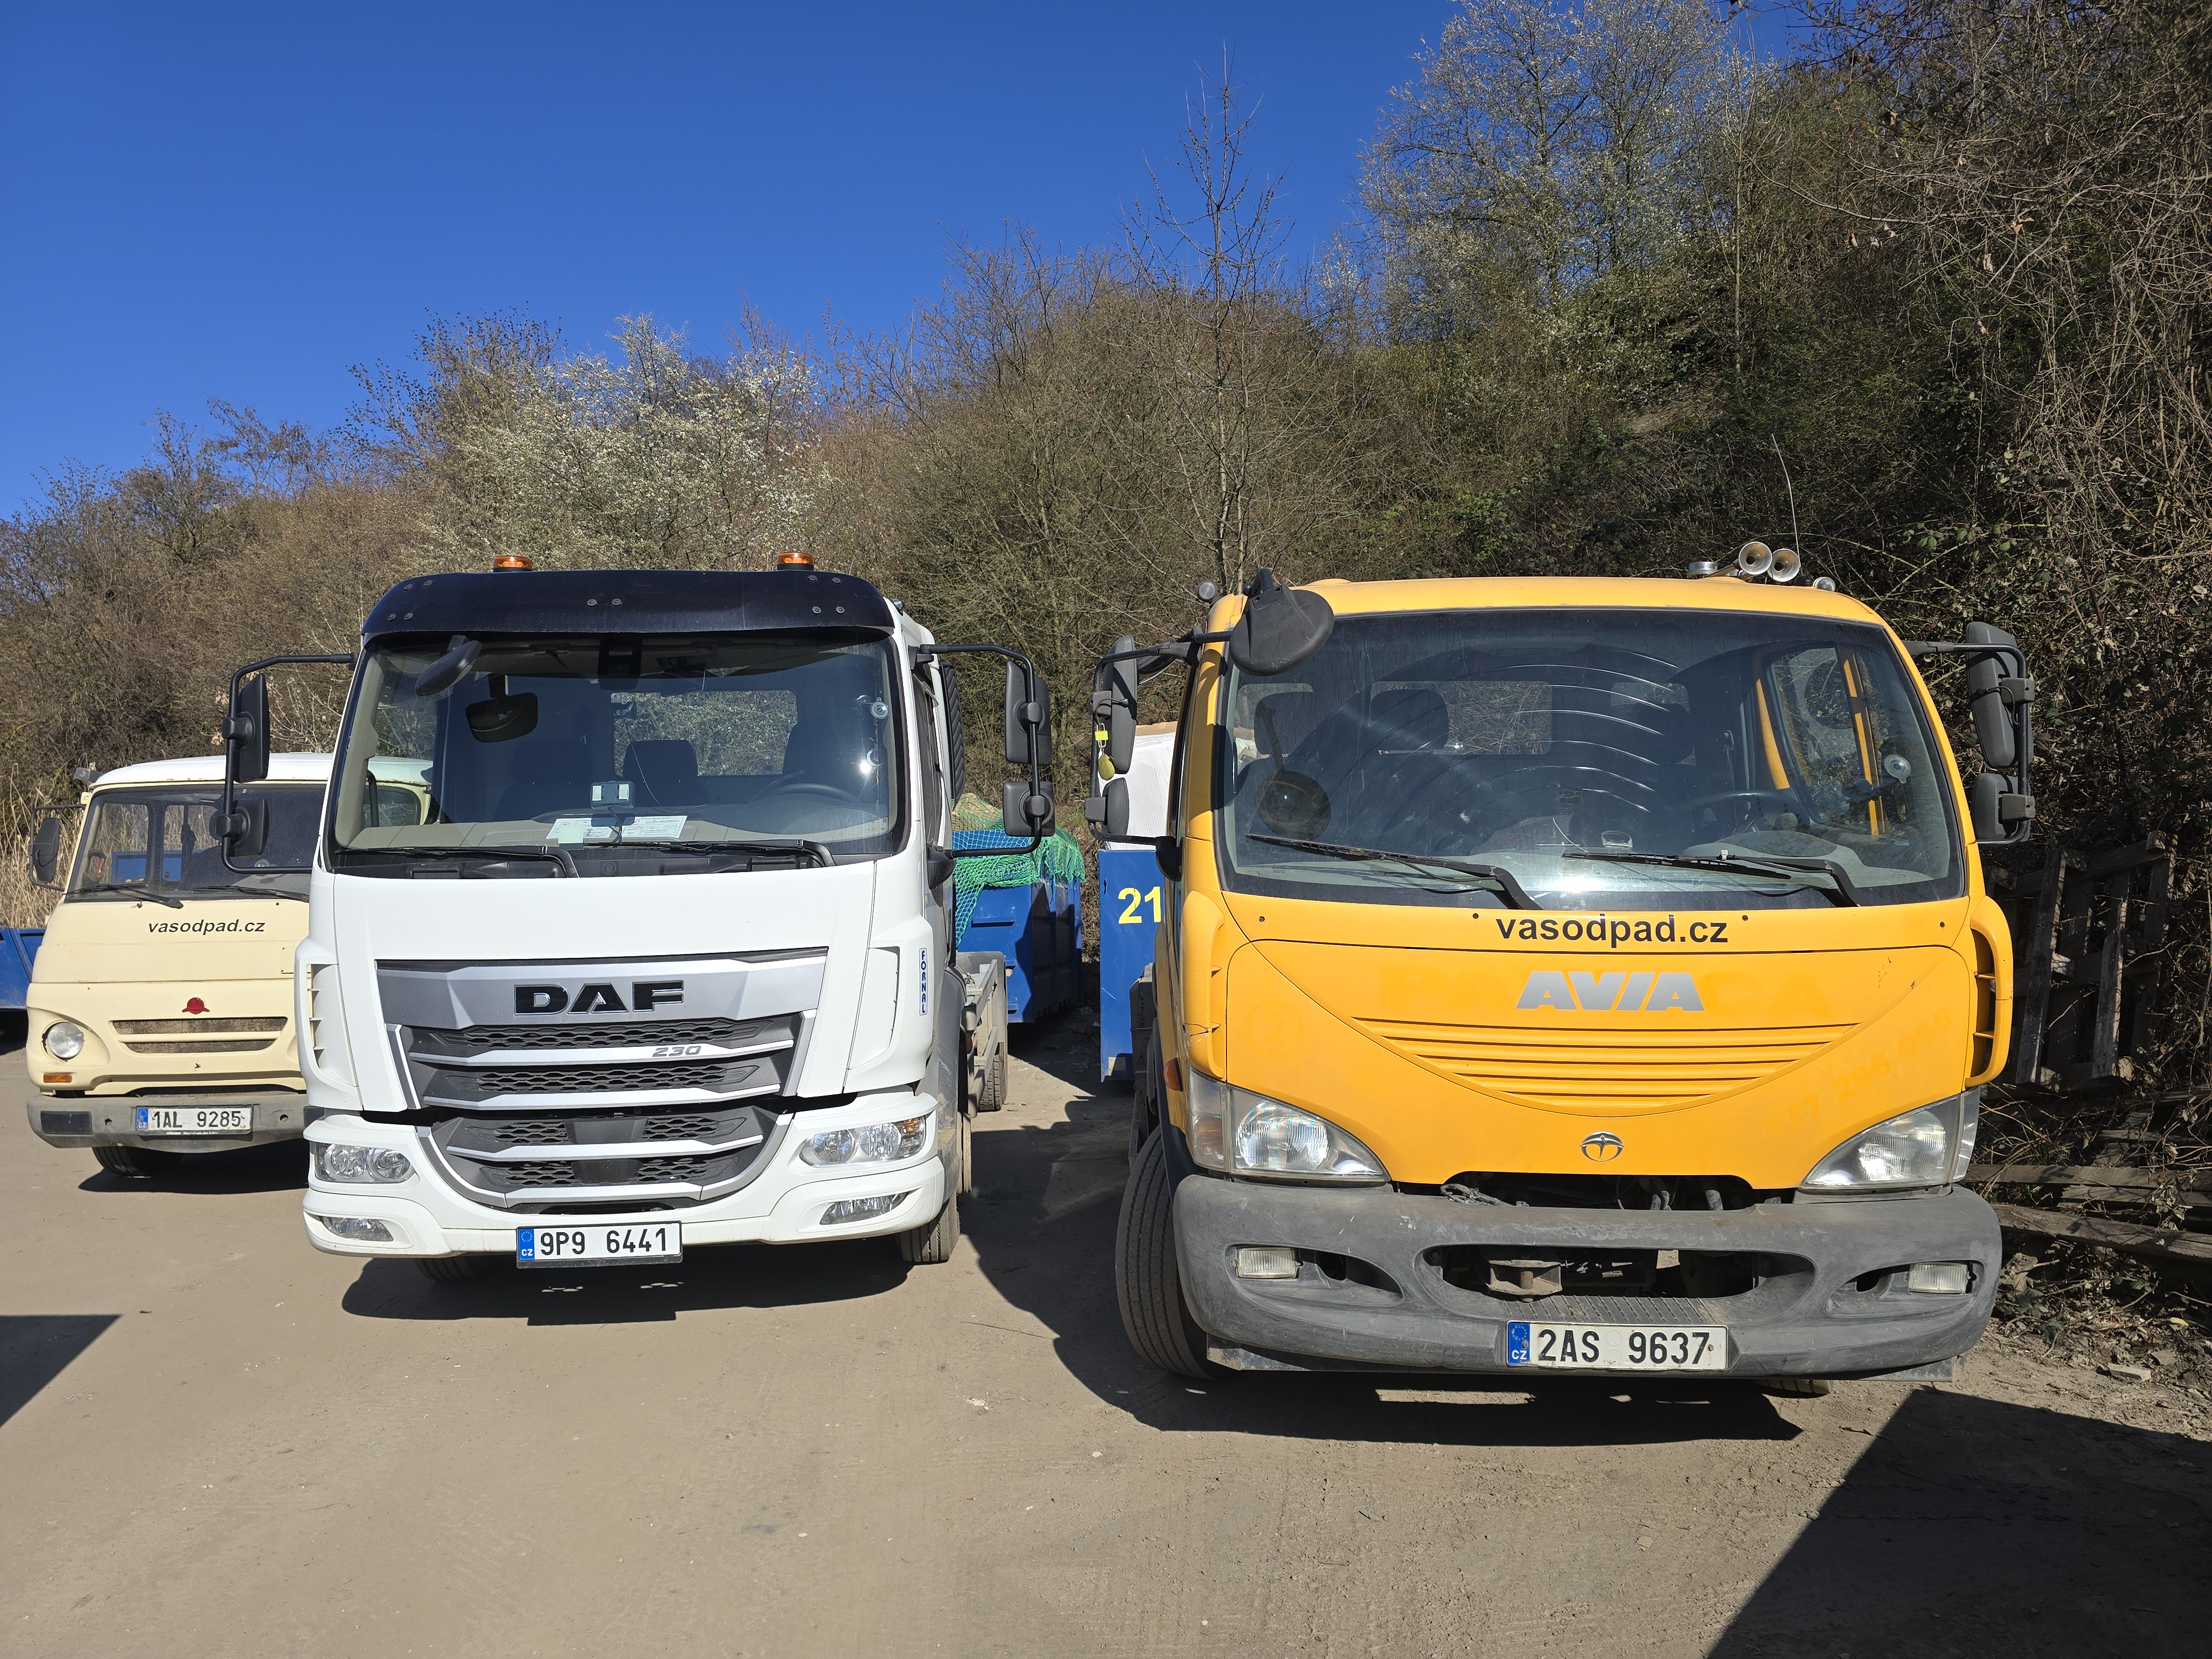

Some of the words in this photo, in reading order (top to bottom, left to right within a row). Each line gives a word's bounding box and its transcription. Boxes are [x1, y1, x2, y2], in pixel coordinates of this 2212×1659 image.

[1118, 886, 1162, 924] 21
[148, 919, 265, 935] vasodpad.cz
[1495, 914, 1728, 948] vasodpad.cz
[513, 979, 684, 1015] DAF
[1515, 971, 1705, 1011] AVIA
[652, 1045, 701, 1057] 230
[154, 1111, 182, 1128] 1AL
[197, 1110, 242, 1128] 9285
[540, 1231, 585, 1256] 9P9
[607, 1228, 666, 1254] 6441
[1511, 1350, 1527, 1360] CZ
[1538, 1329, 1600, 1363] 2AS
[1629, 1332, 1710, 1364] 9637
